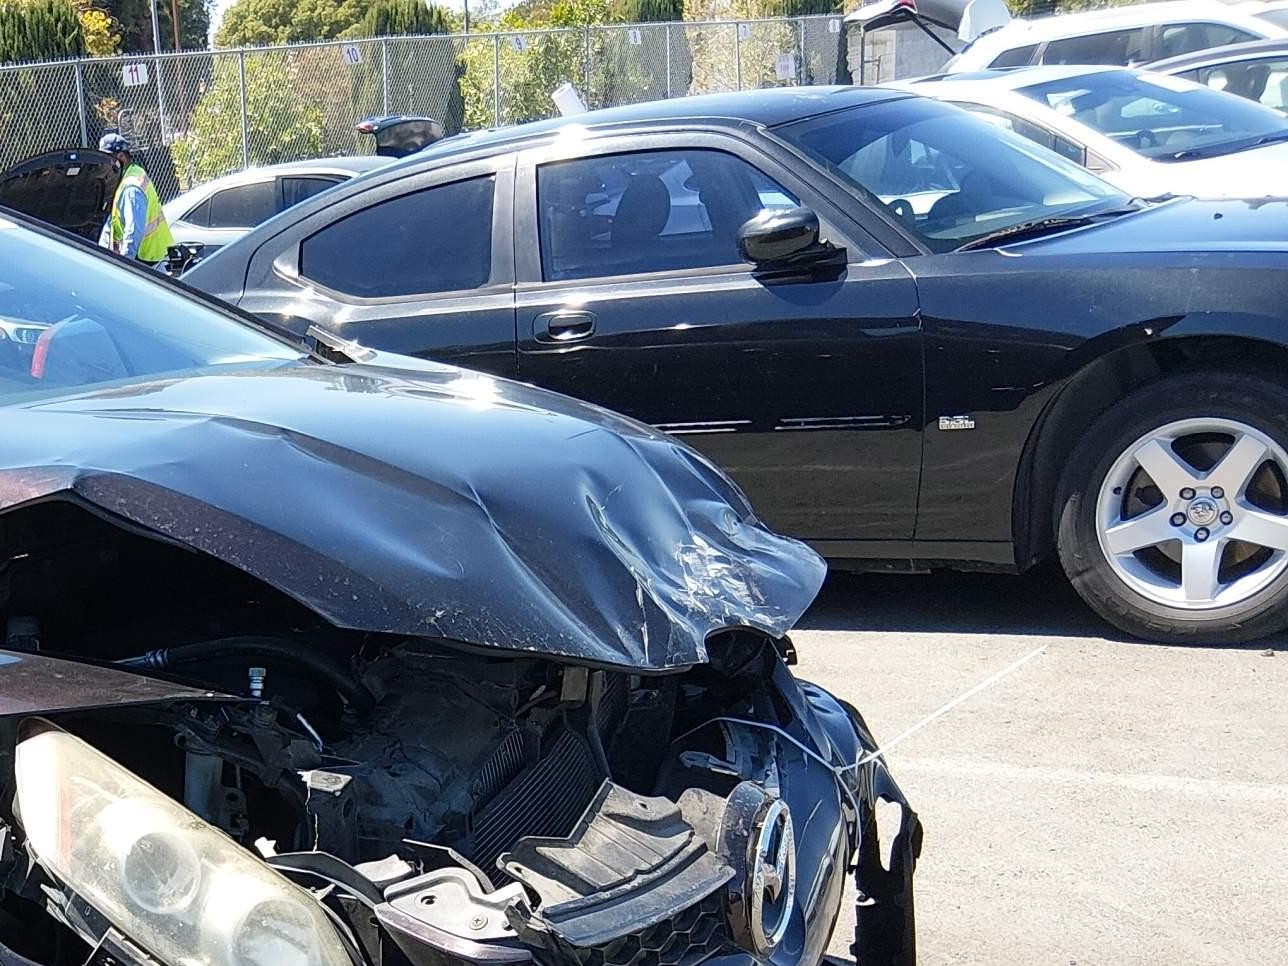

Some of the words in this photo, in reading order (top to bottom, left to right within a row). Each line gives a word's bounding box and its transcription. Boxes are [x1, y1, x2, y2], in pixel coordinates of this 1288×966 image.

[515, 37, 523, 50] 9
[347, 47, 359, 63] 10
[129, 65, 140, 84] 11
